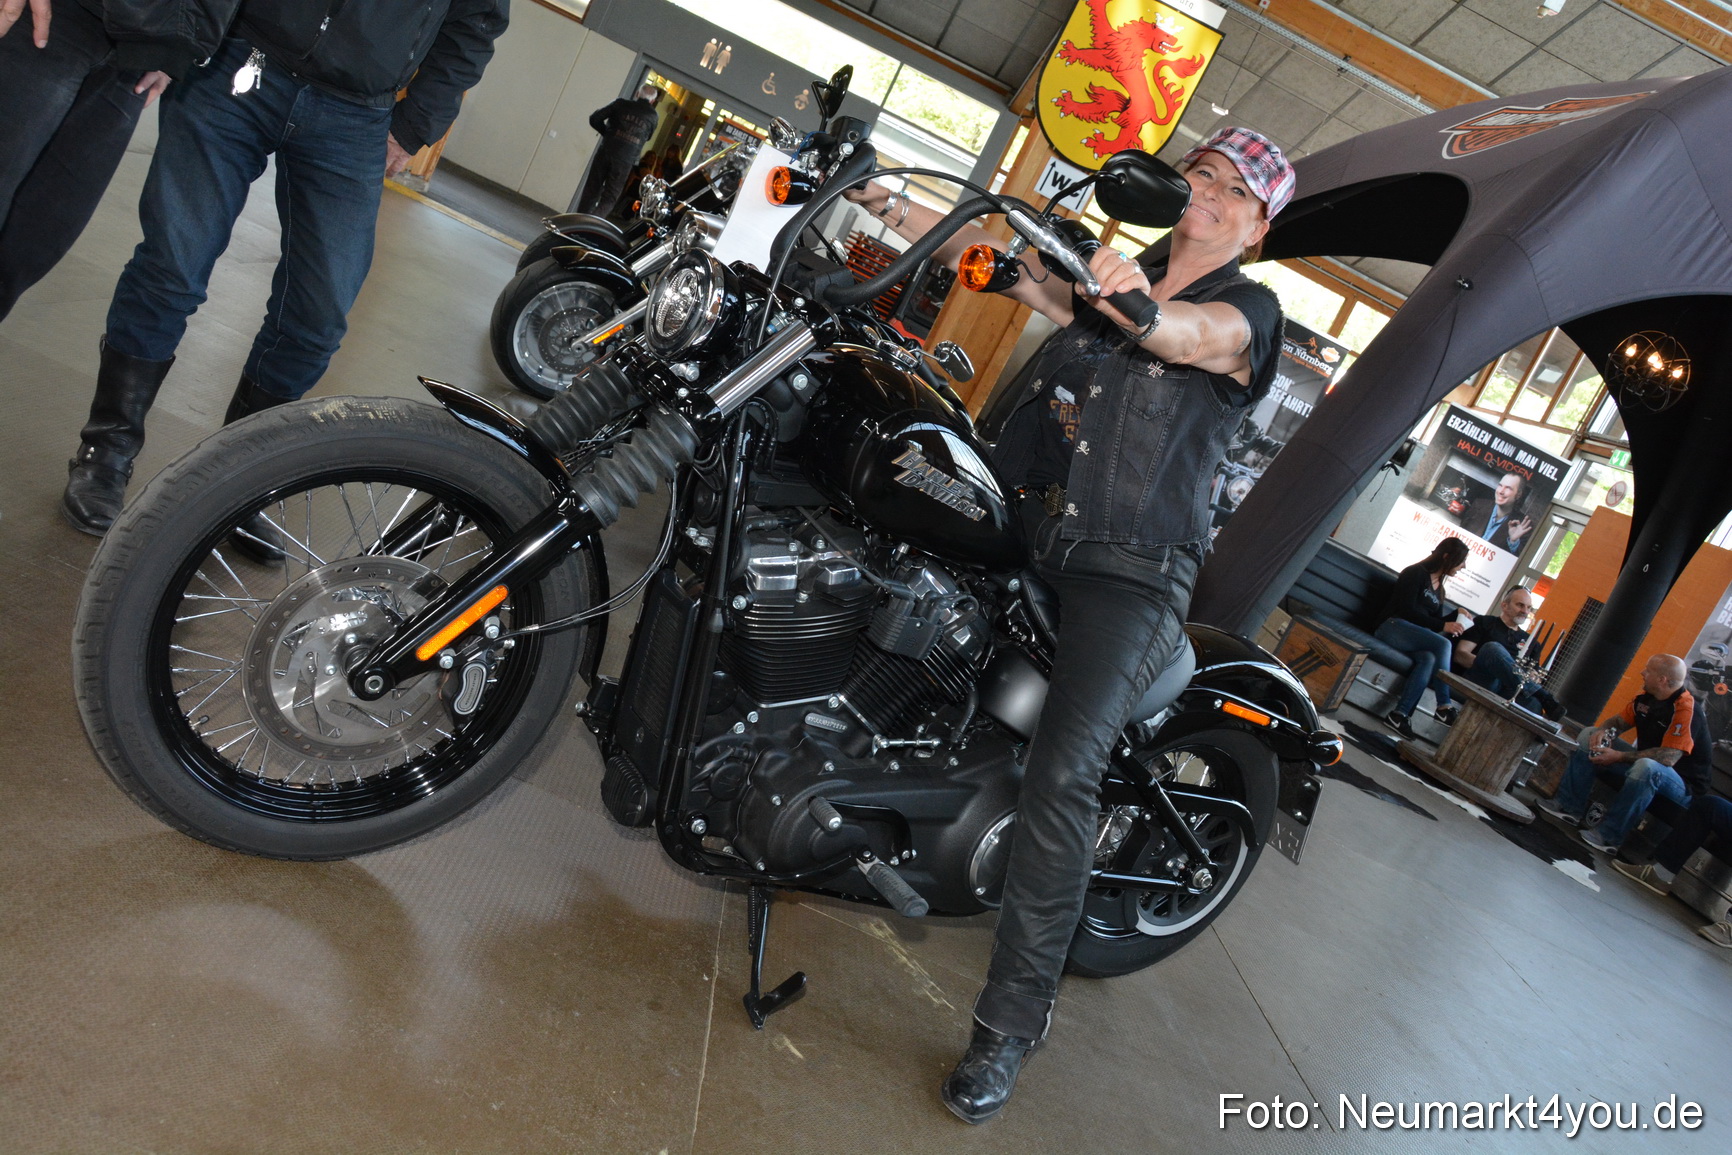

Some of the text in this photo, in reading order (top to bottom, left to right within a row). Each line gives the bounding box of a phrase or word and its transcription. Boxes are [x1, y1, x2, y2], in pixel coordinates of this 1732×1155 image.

[1294, 348, 1334, 376] Nürnberg
[1267, 386, 1314, 419] BEFAHRT!
[1446, 414, 1559, 482] ERZÄHLEN KANN MAN VIEL.
[1457, 439, 1482, 457] HALI
[894, 469, 987, 521] DAVIDSON
